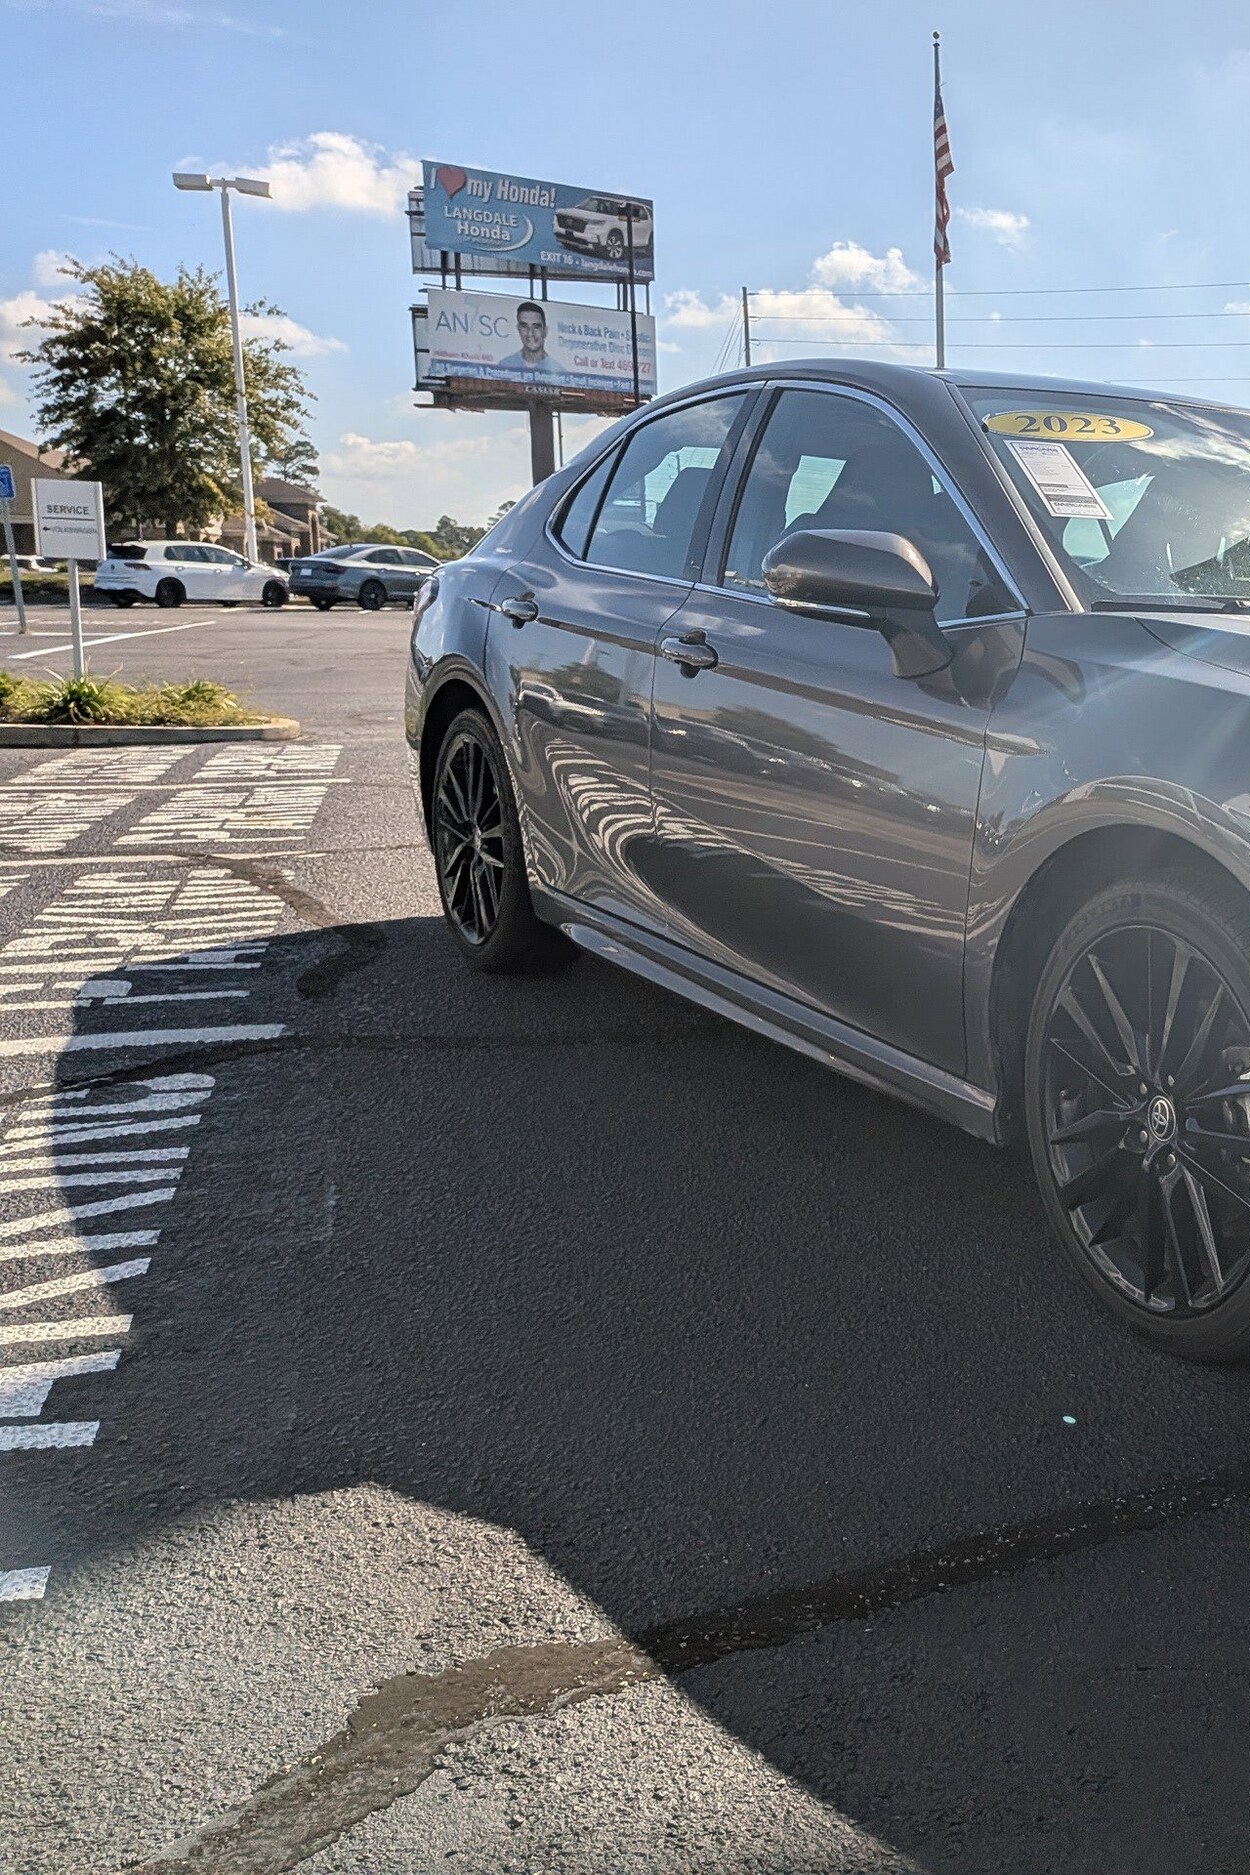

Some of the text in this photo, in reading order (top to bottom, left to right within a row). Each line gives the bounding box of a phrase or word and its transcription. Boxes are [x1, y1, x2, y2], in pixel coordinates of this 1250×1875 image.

[430, 168, 556, 208] I my Honda!
[444, 206, 518, 227] LANGDALE
[457, 221, 511, 240] Honda
[541, 251, 561, 262] EXIT
[435, 310, 511, 338] AN SC
[583, 324, 602, 337] Back
[574, 355, 588, 367] Call
[590, 359, 597, 368] or
[600, 358, 615, 370] Text
[1014, 415, 1121, 435] 2023
[47, 505, 90, 515] SERVICE
